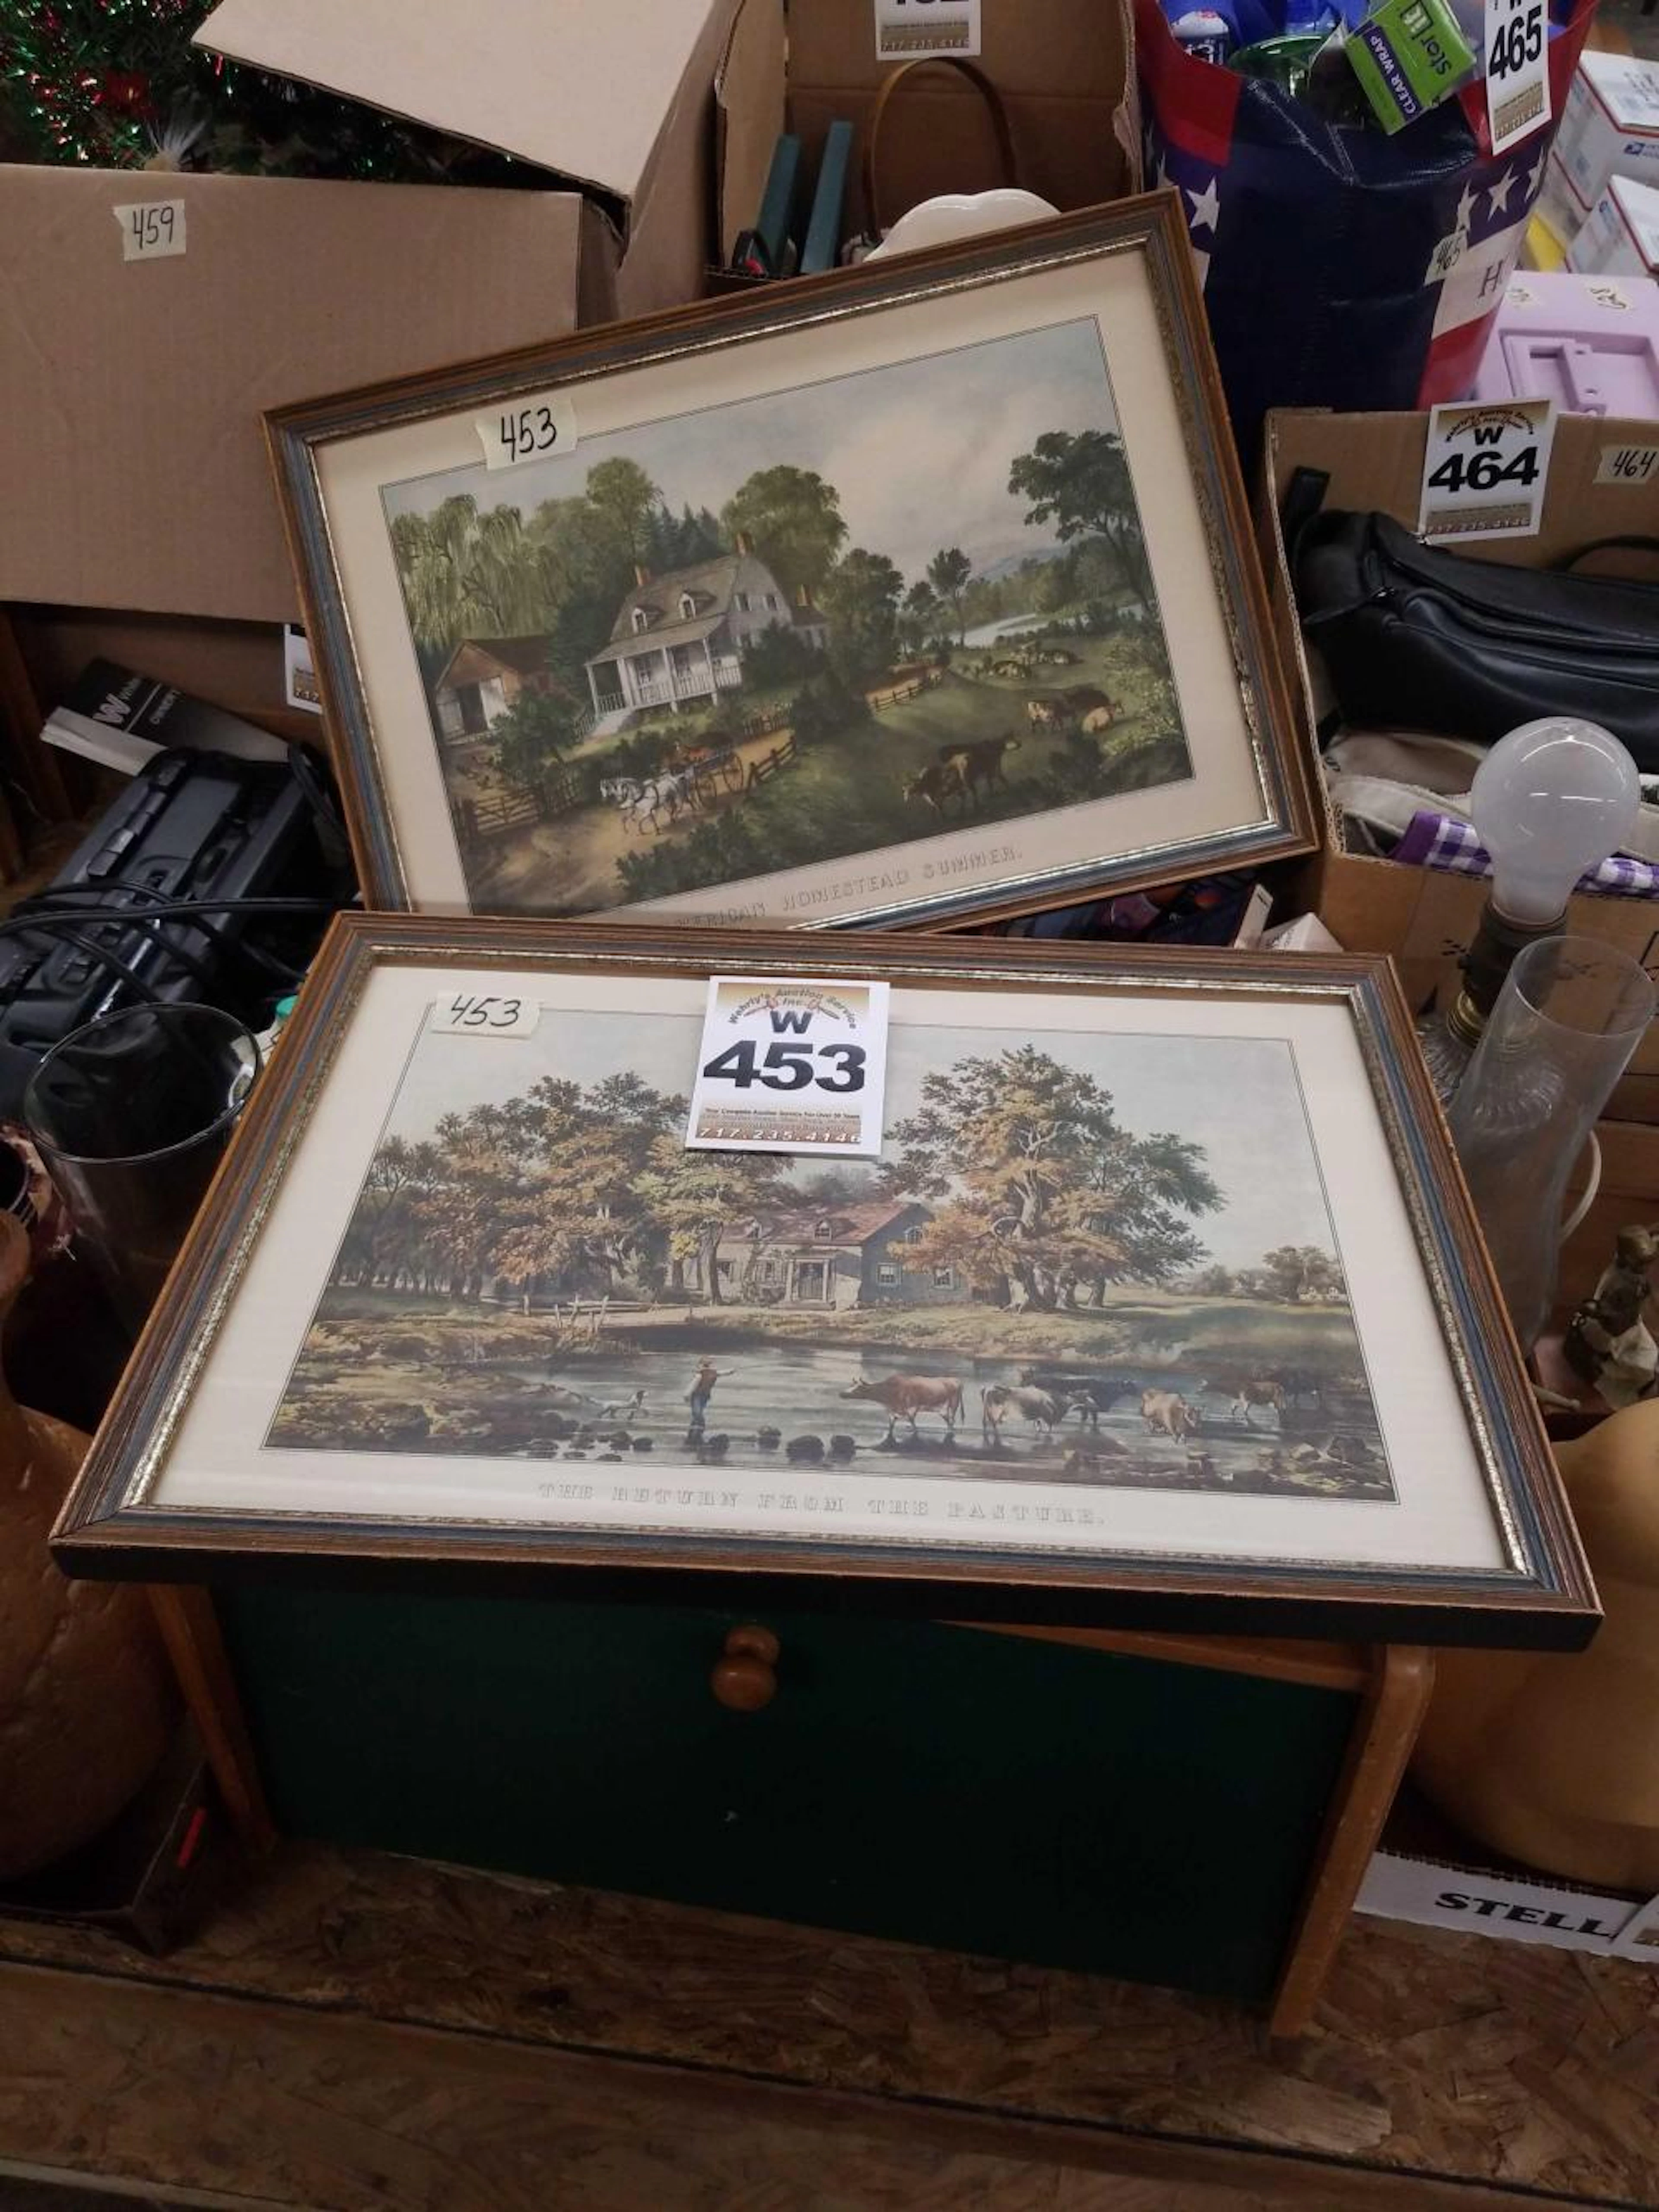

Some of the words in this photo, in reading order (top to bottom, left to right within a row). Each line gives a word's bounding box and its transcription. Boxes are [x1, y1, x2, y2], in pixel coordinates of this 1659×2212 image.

[1370, 35, 1395, 75] WRAP
[1489, 4, 1541, 80] 465
[1390, 73, 1416, 114] CLEAR
[133, 206, 174, 250] 459
[501, 407, 557, 463] 453
[1474, 426, 1504, 445] W
[1428, 446, 1540, 493] 464
[1614, 450, 1658, 477] 464
[783, 870, 911, 911] HOMESTEAD
[451, 994, 521, 1027] 453
[770, 1010, 813, 1034] W
[703, 1040, 866, 1093] 453
[1434, 1892, 1618, 1939] STELL
